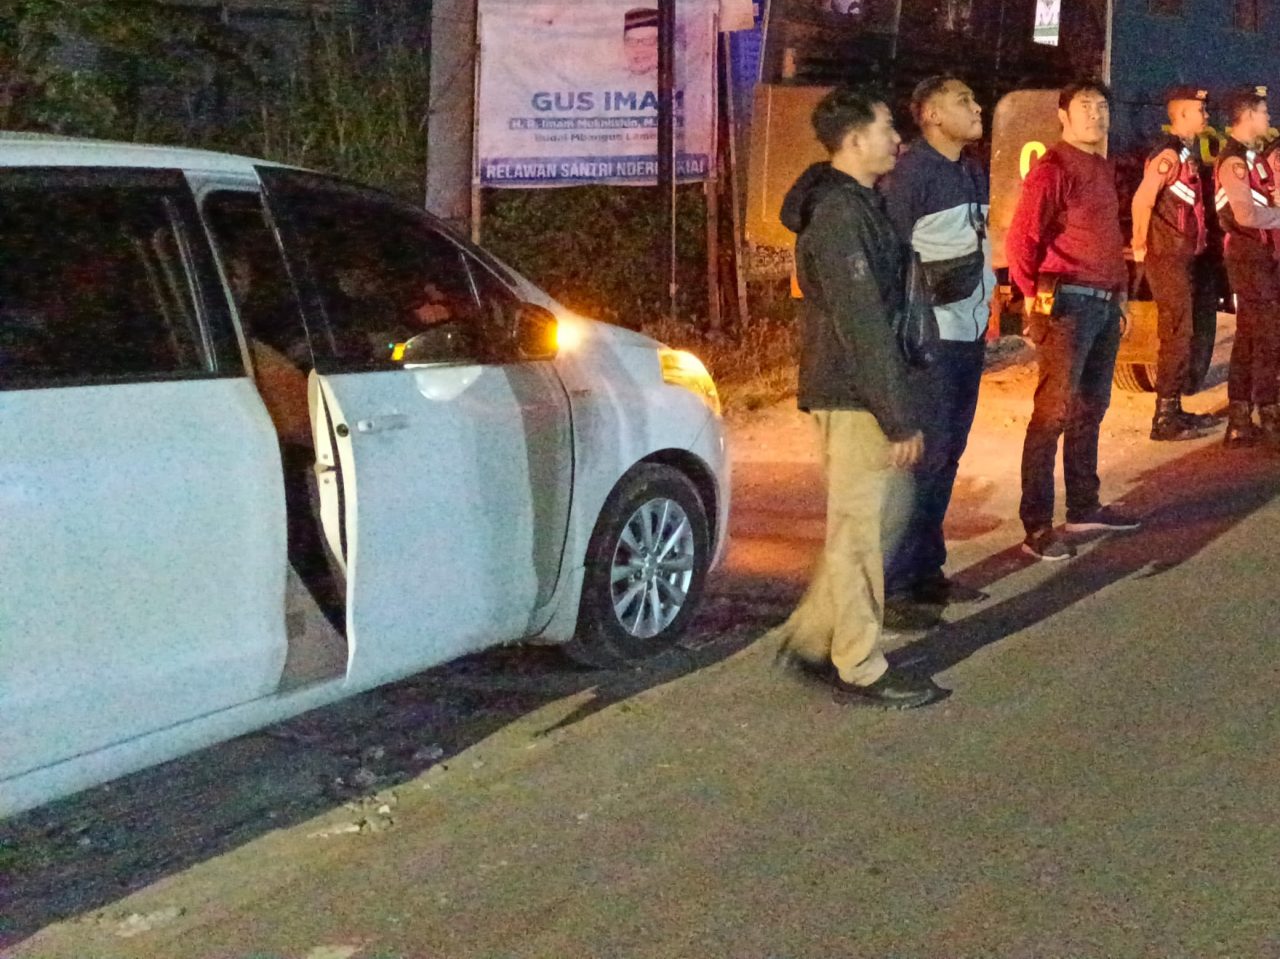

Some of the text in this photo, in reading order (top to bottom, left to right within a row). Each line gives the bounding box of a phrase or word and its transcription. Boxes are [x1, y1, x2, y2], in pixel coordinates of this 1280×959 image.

[531, 91, 594, 111] GUS
[486, 163, 557, 179] RELAWAN
[560, 162, 612, 177] SANTRI
